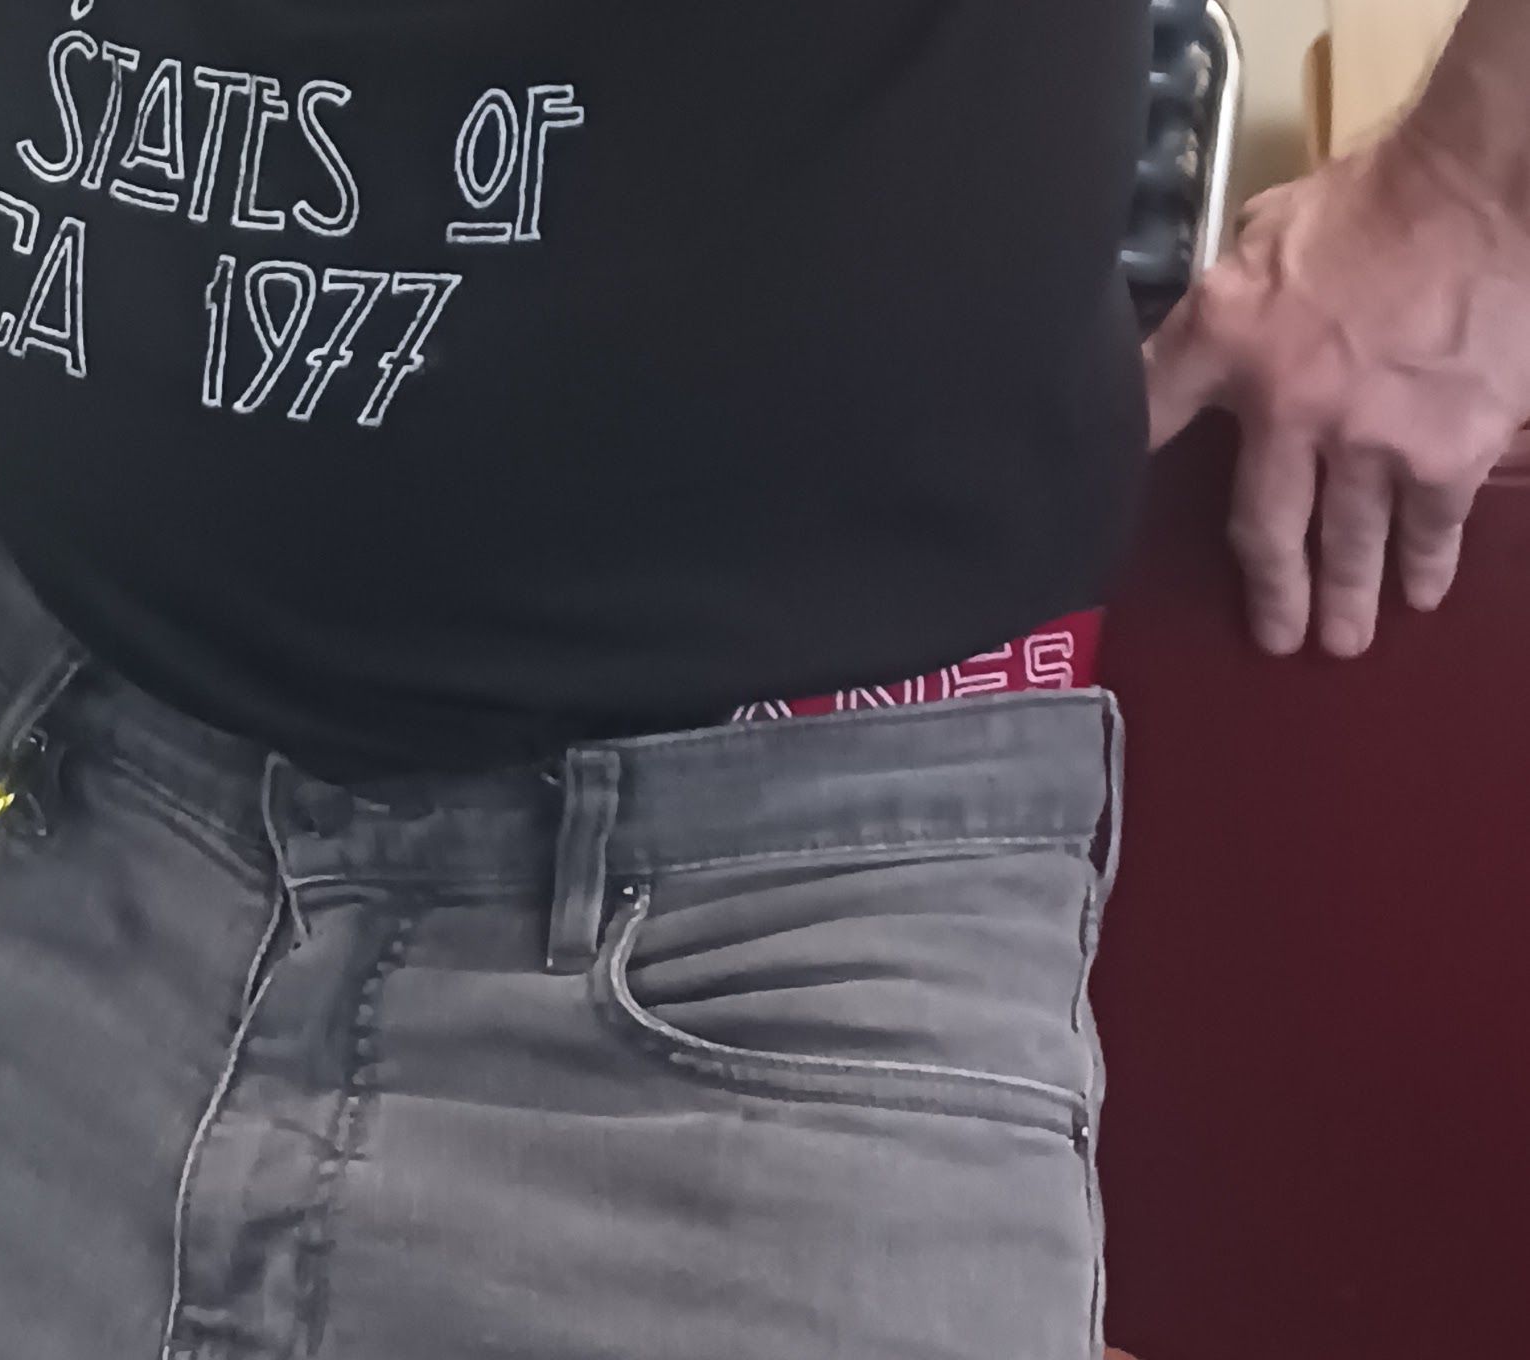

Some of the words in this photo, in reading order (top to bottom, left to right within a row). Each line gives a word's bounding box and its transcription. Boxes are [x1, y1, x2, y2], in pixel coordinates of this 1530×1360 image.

[16, 30, 360, 237] STATES
[446, 84, 585, 243] OF
[202, 254, 463, 427] 1977
